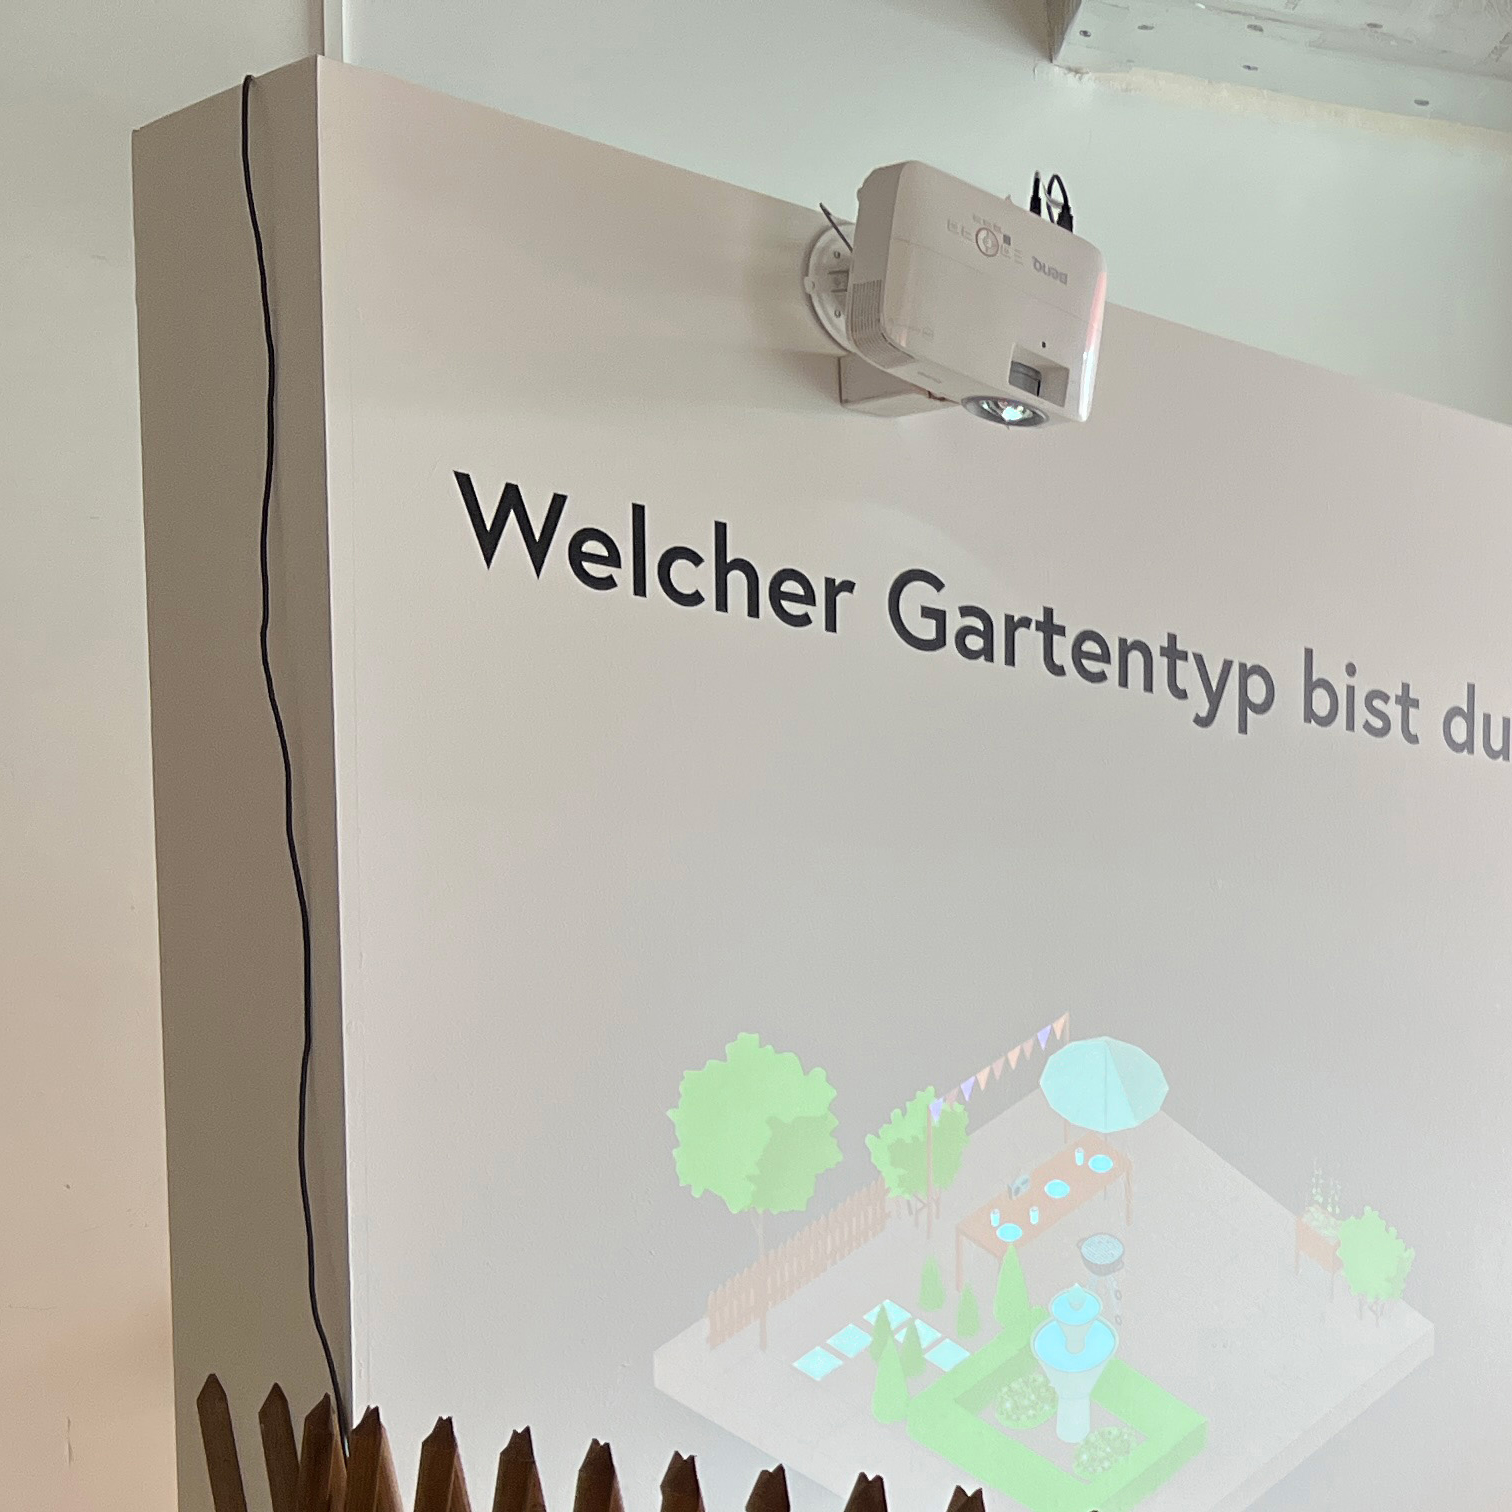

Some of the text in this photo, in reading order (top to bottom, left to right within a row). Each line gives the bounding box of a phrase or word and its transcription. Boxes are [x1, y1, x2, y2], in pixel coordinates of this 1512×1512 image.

[453, 470, 856, 633] Welcher
[888, 568, 1275, 735] Gartentyp
[1304, 646, 1419, 745] bist
